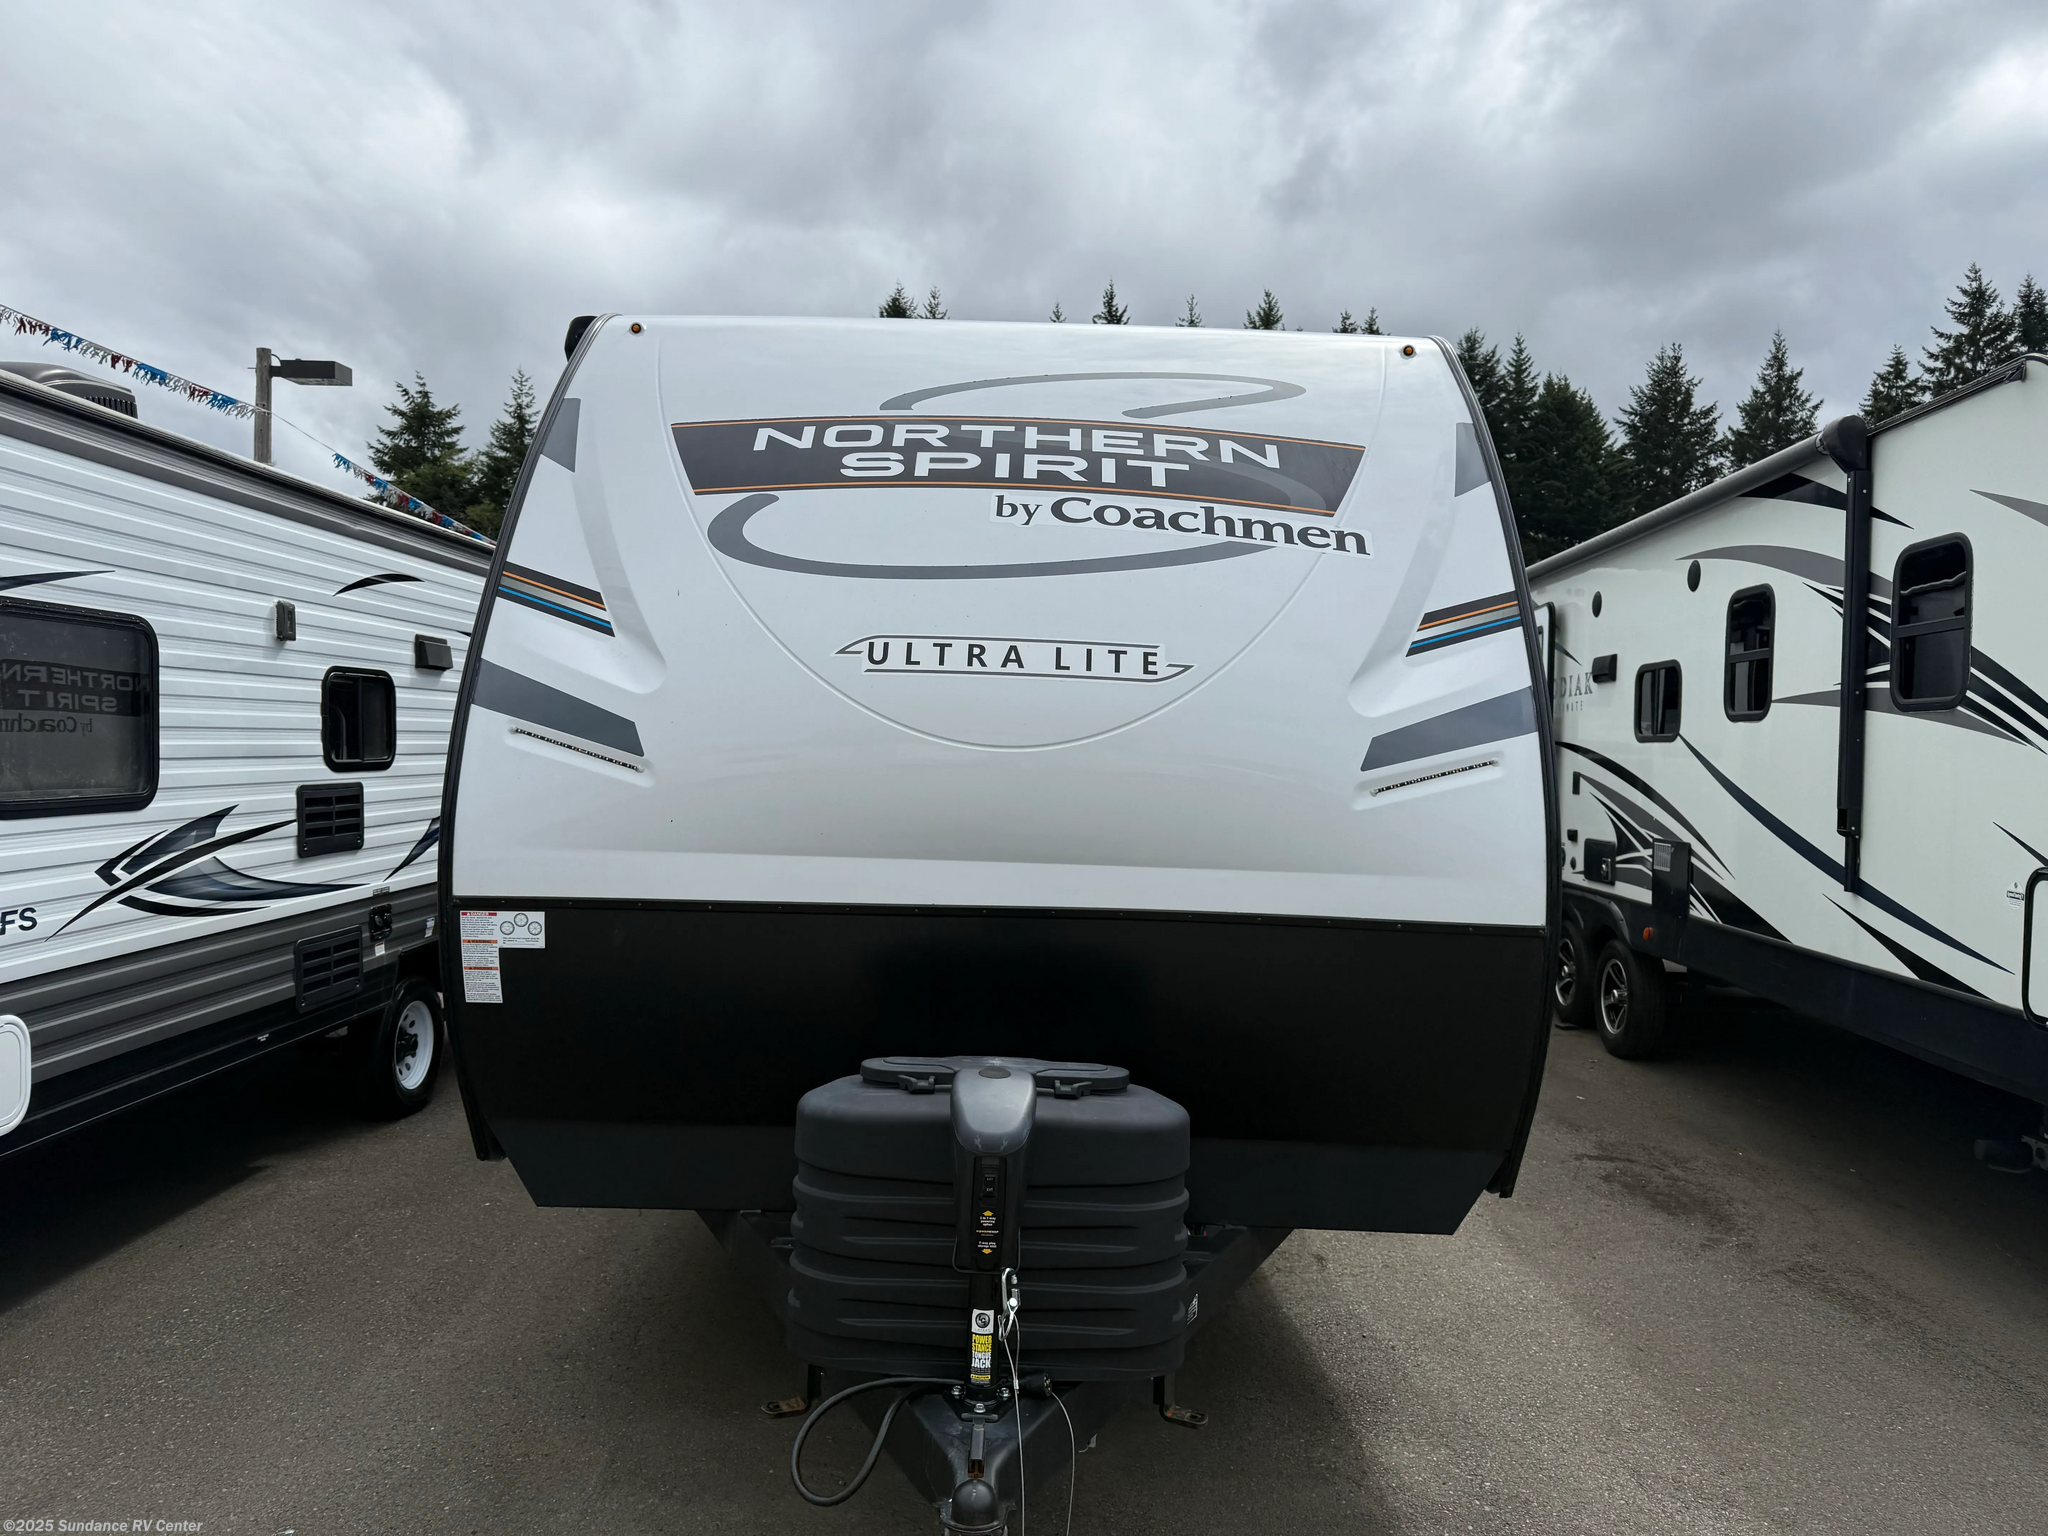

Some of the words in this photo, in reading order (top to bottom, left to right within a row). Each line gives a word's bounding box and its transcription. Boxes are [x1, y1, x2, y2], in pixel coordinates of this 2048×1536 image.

[753, 424, 1281, 469] NORTHERN
[840, 451, 1190, 488] SPIRIT
[995, 494, 1043, 526] by
[1050, 496, 1371, 556] Coachmen
[867, 641, 1026, 669] ULTRA
[1055, 646, 1159, 676] LITE
